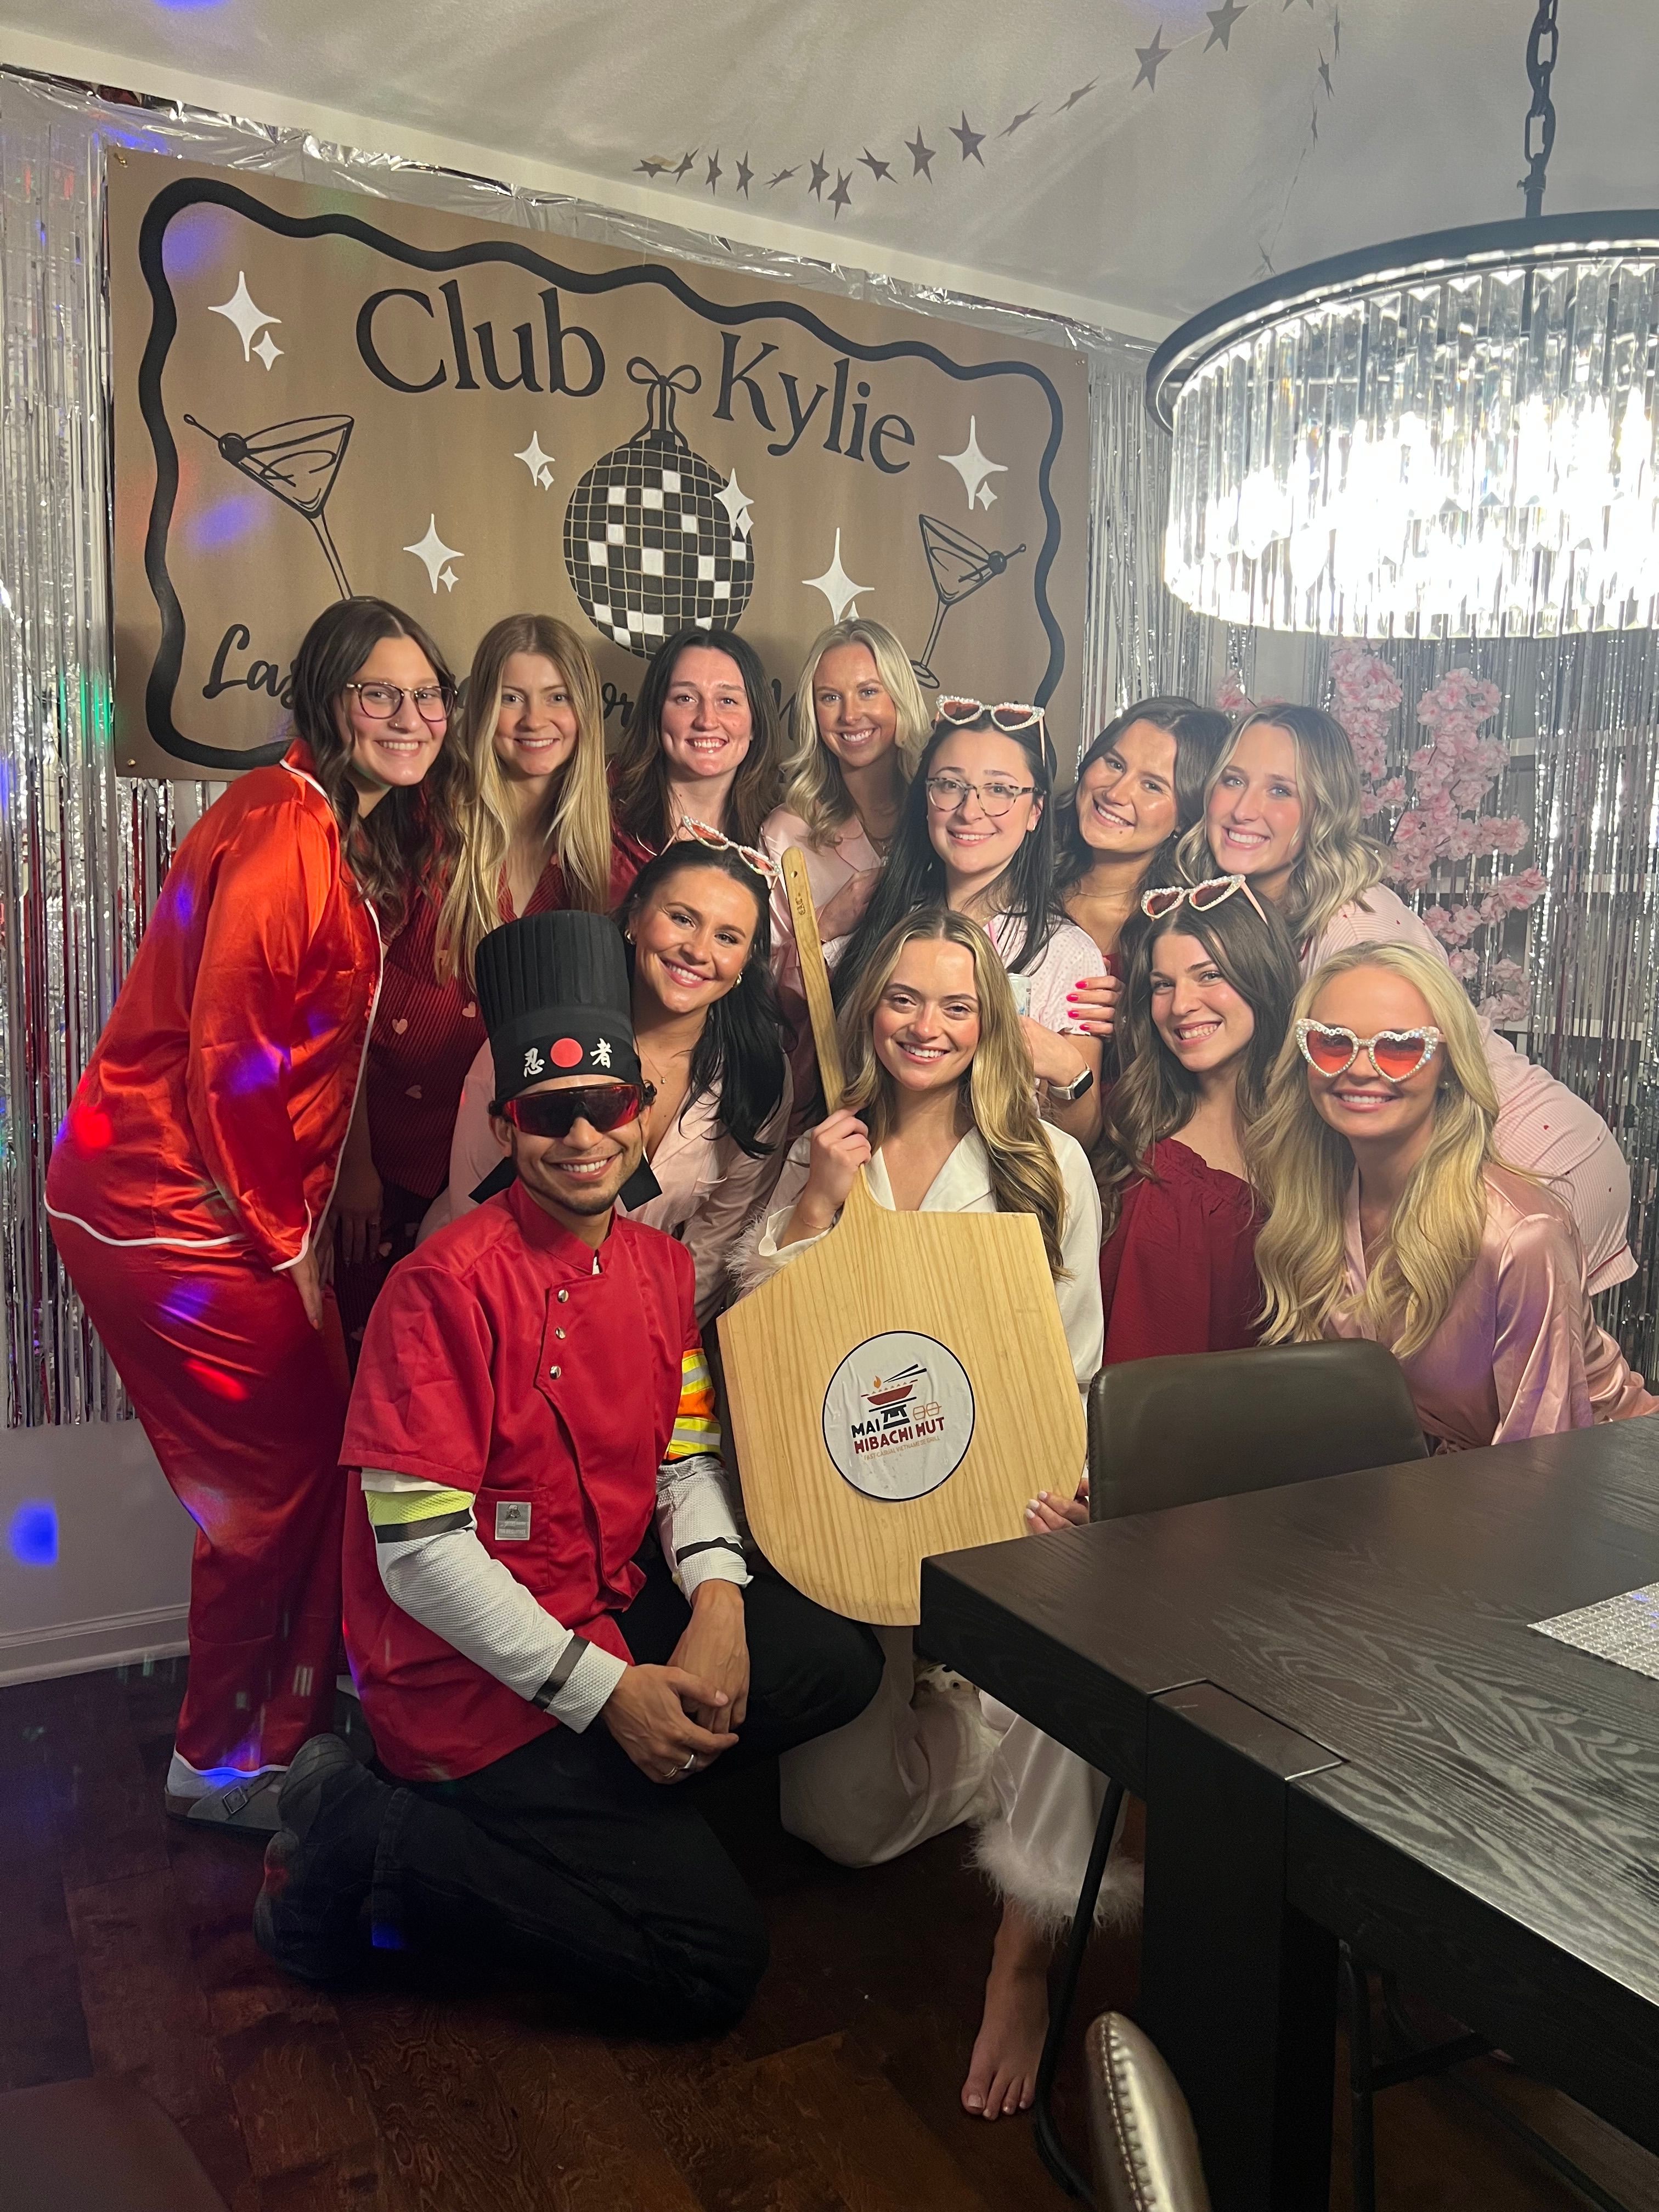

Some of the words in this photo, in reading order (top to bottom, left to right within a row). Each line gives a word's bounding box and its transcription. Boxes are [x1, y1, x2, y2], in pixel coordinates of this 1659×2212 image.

[357, 279, 605, 397] Club
[713, 331, 916, 474] Kylie
[523, 1047, 545, 1077] 忍
[589, 1038, 613, 1069] 者
[851, 1418, 881, 1438] MAI
[854, 1426, 914, 1454] HIBACHI
[915, 1416, 945, 1437] HUT
